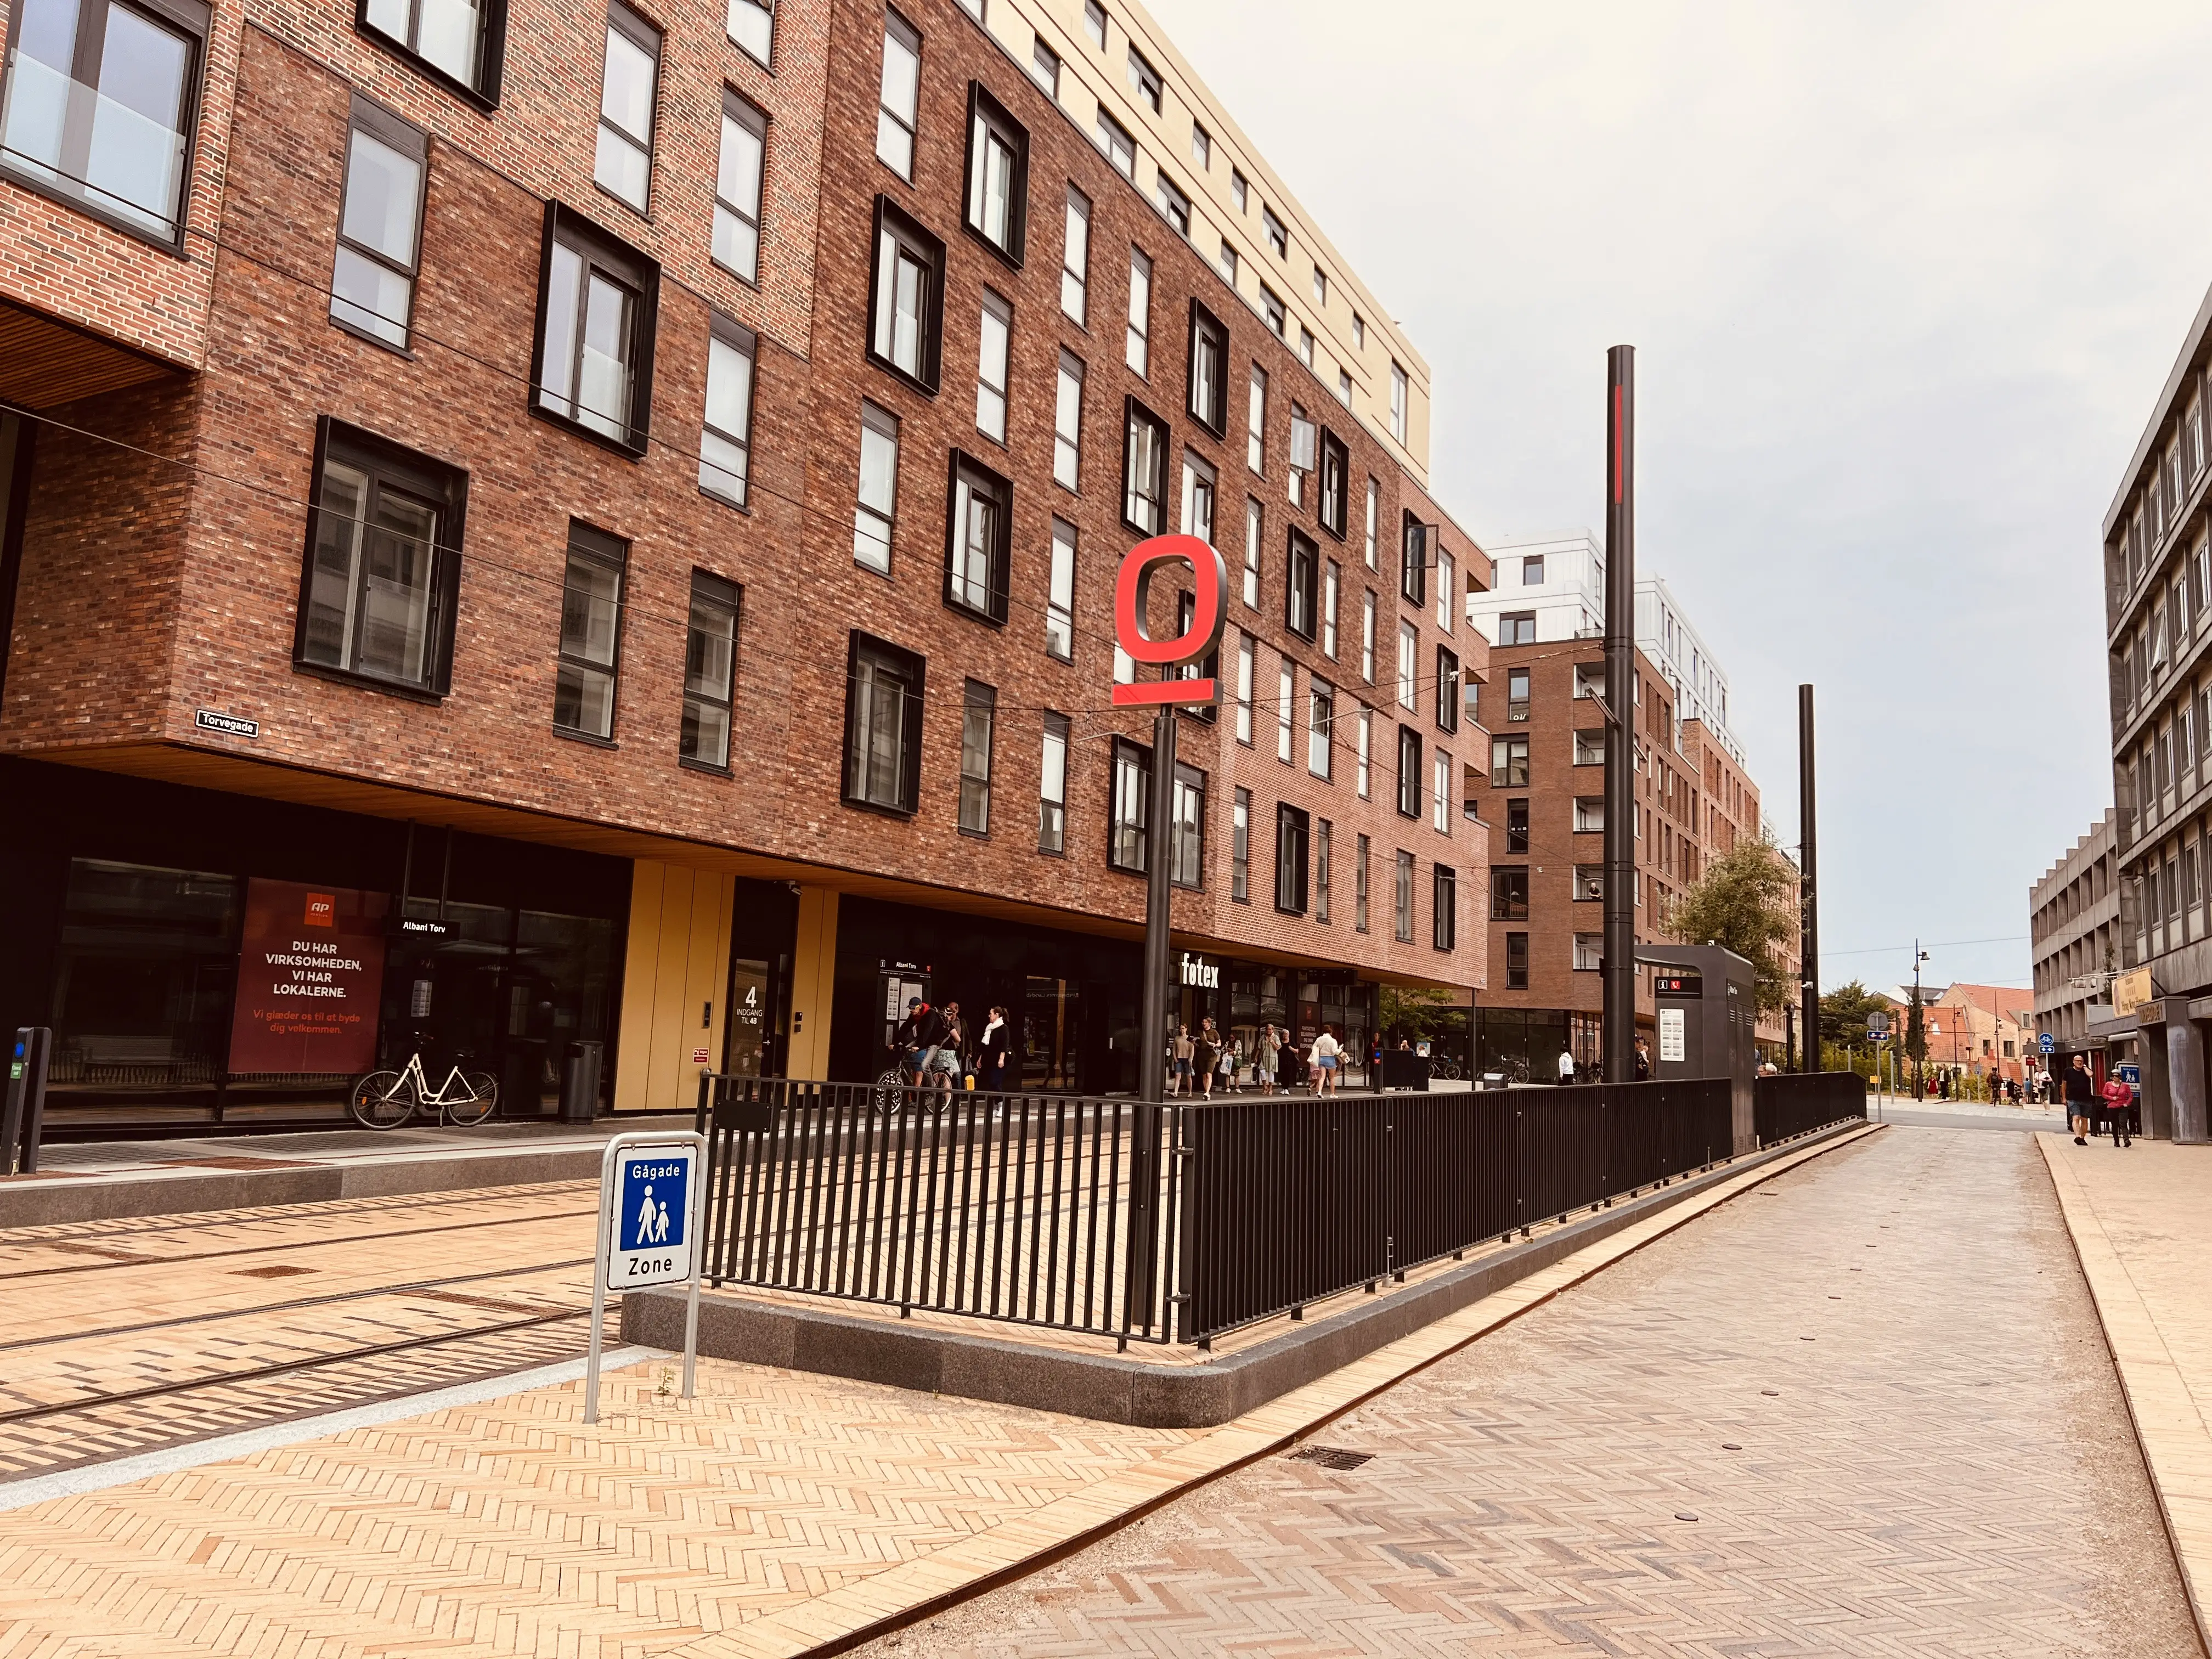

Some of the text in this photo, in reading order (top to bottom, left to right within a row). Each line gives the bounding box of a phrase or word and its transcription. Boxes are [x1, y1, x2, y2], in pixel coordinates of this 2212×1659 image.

[203, 713, 253, 732] Torvegade
[311, 902, 329, 912] AP
[403, 922, 446, 933] Albani Torv
[292, 941, 337, 955] DU HAR
[266, 953, 362, 972] VIRKSOMHEDEN,
[292, 970, 332, 983] VI HAR
[1182, 953, 1219, 989] føtex
[273, 984, 346, 998] LOKALERNE.
[745, 986, 757, 1008] 4
[253, 1009, 264, 1019] Vi
[266, 1010, 299, 1021] glæder
[314, 1012, 324, 1021] til
[338, 1013, 360, 1024] byde
[736, 1008, 763, 1017] INDGANG
[270, 1023, 342, 1034] dig velkommen.
[633, 1164, 680, 1180] Gågade
[628, 1257, 673, 1276] Zone
